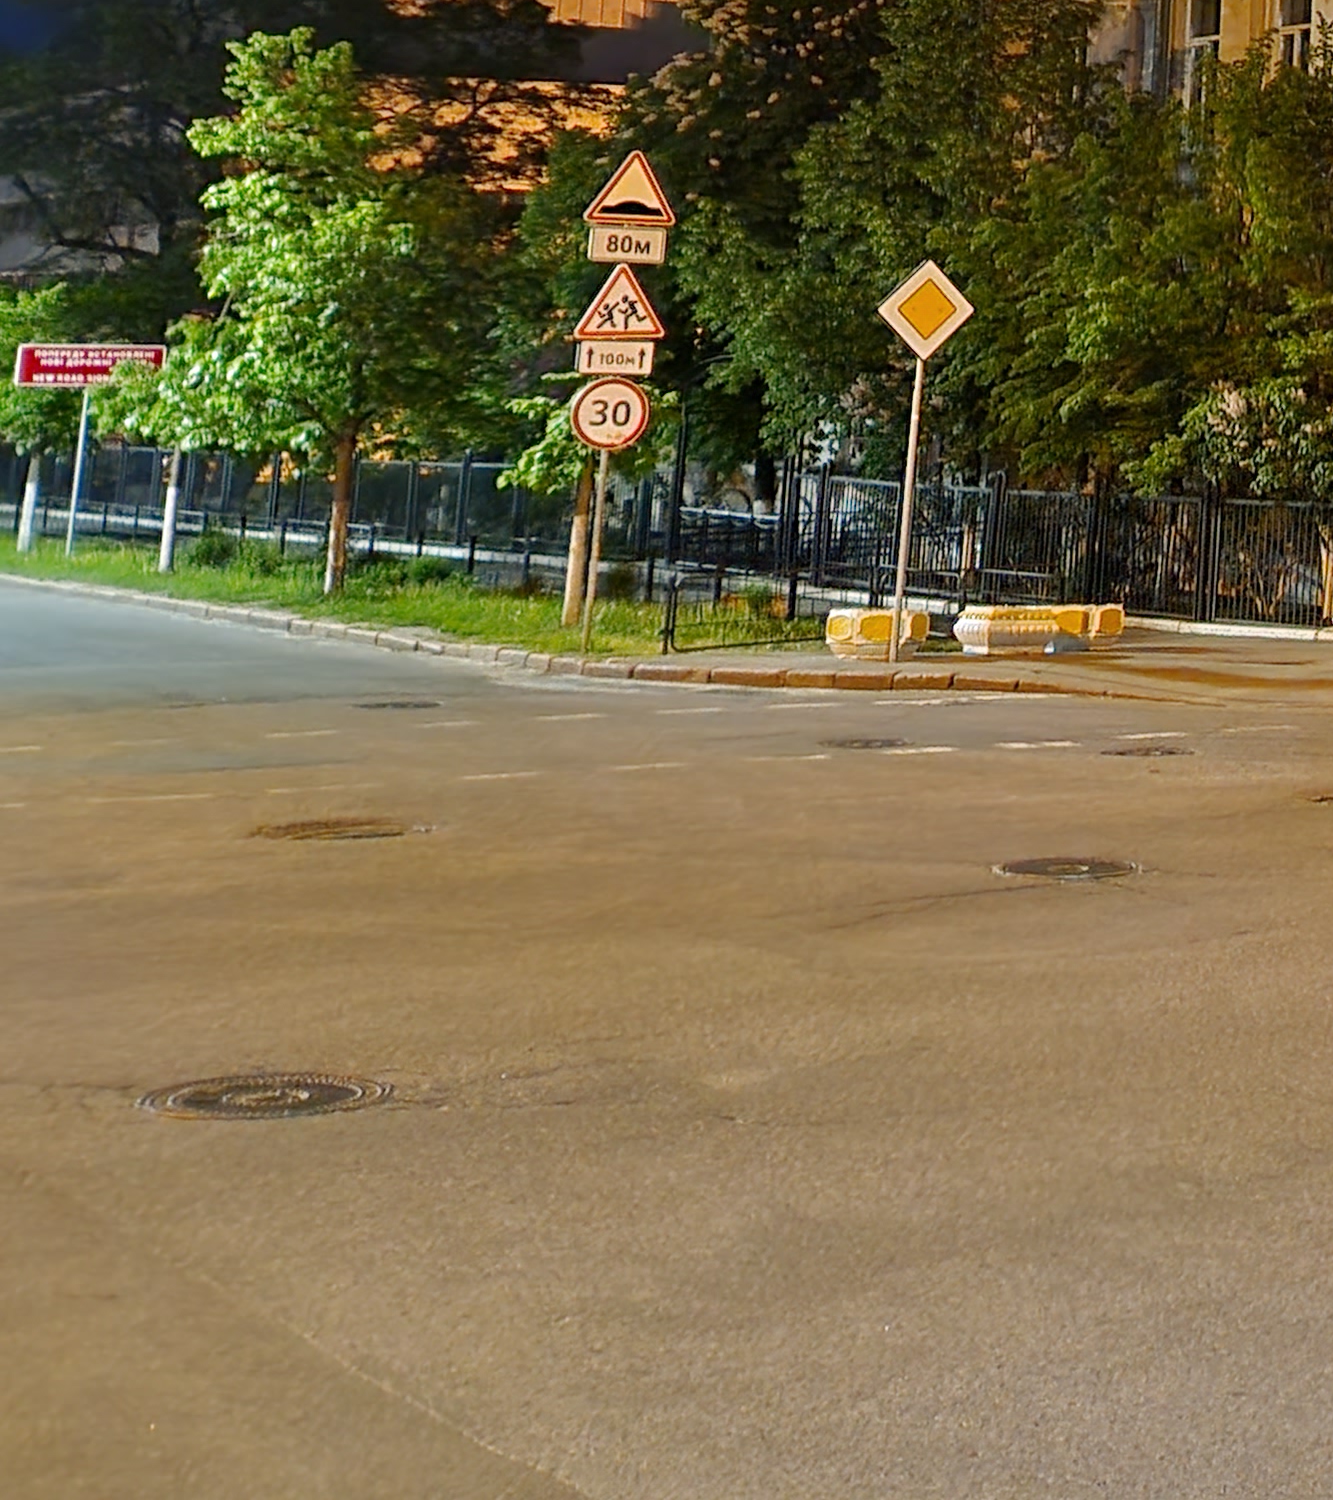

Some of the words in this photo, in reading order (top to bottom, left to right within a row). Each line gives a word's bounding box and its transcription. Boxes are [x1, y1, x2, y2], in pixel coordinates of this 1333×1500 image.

[32, 373, 55, 382] NEW
[56, 373, 85, 382] ROAD
[589, 400, 631, 427] 30
